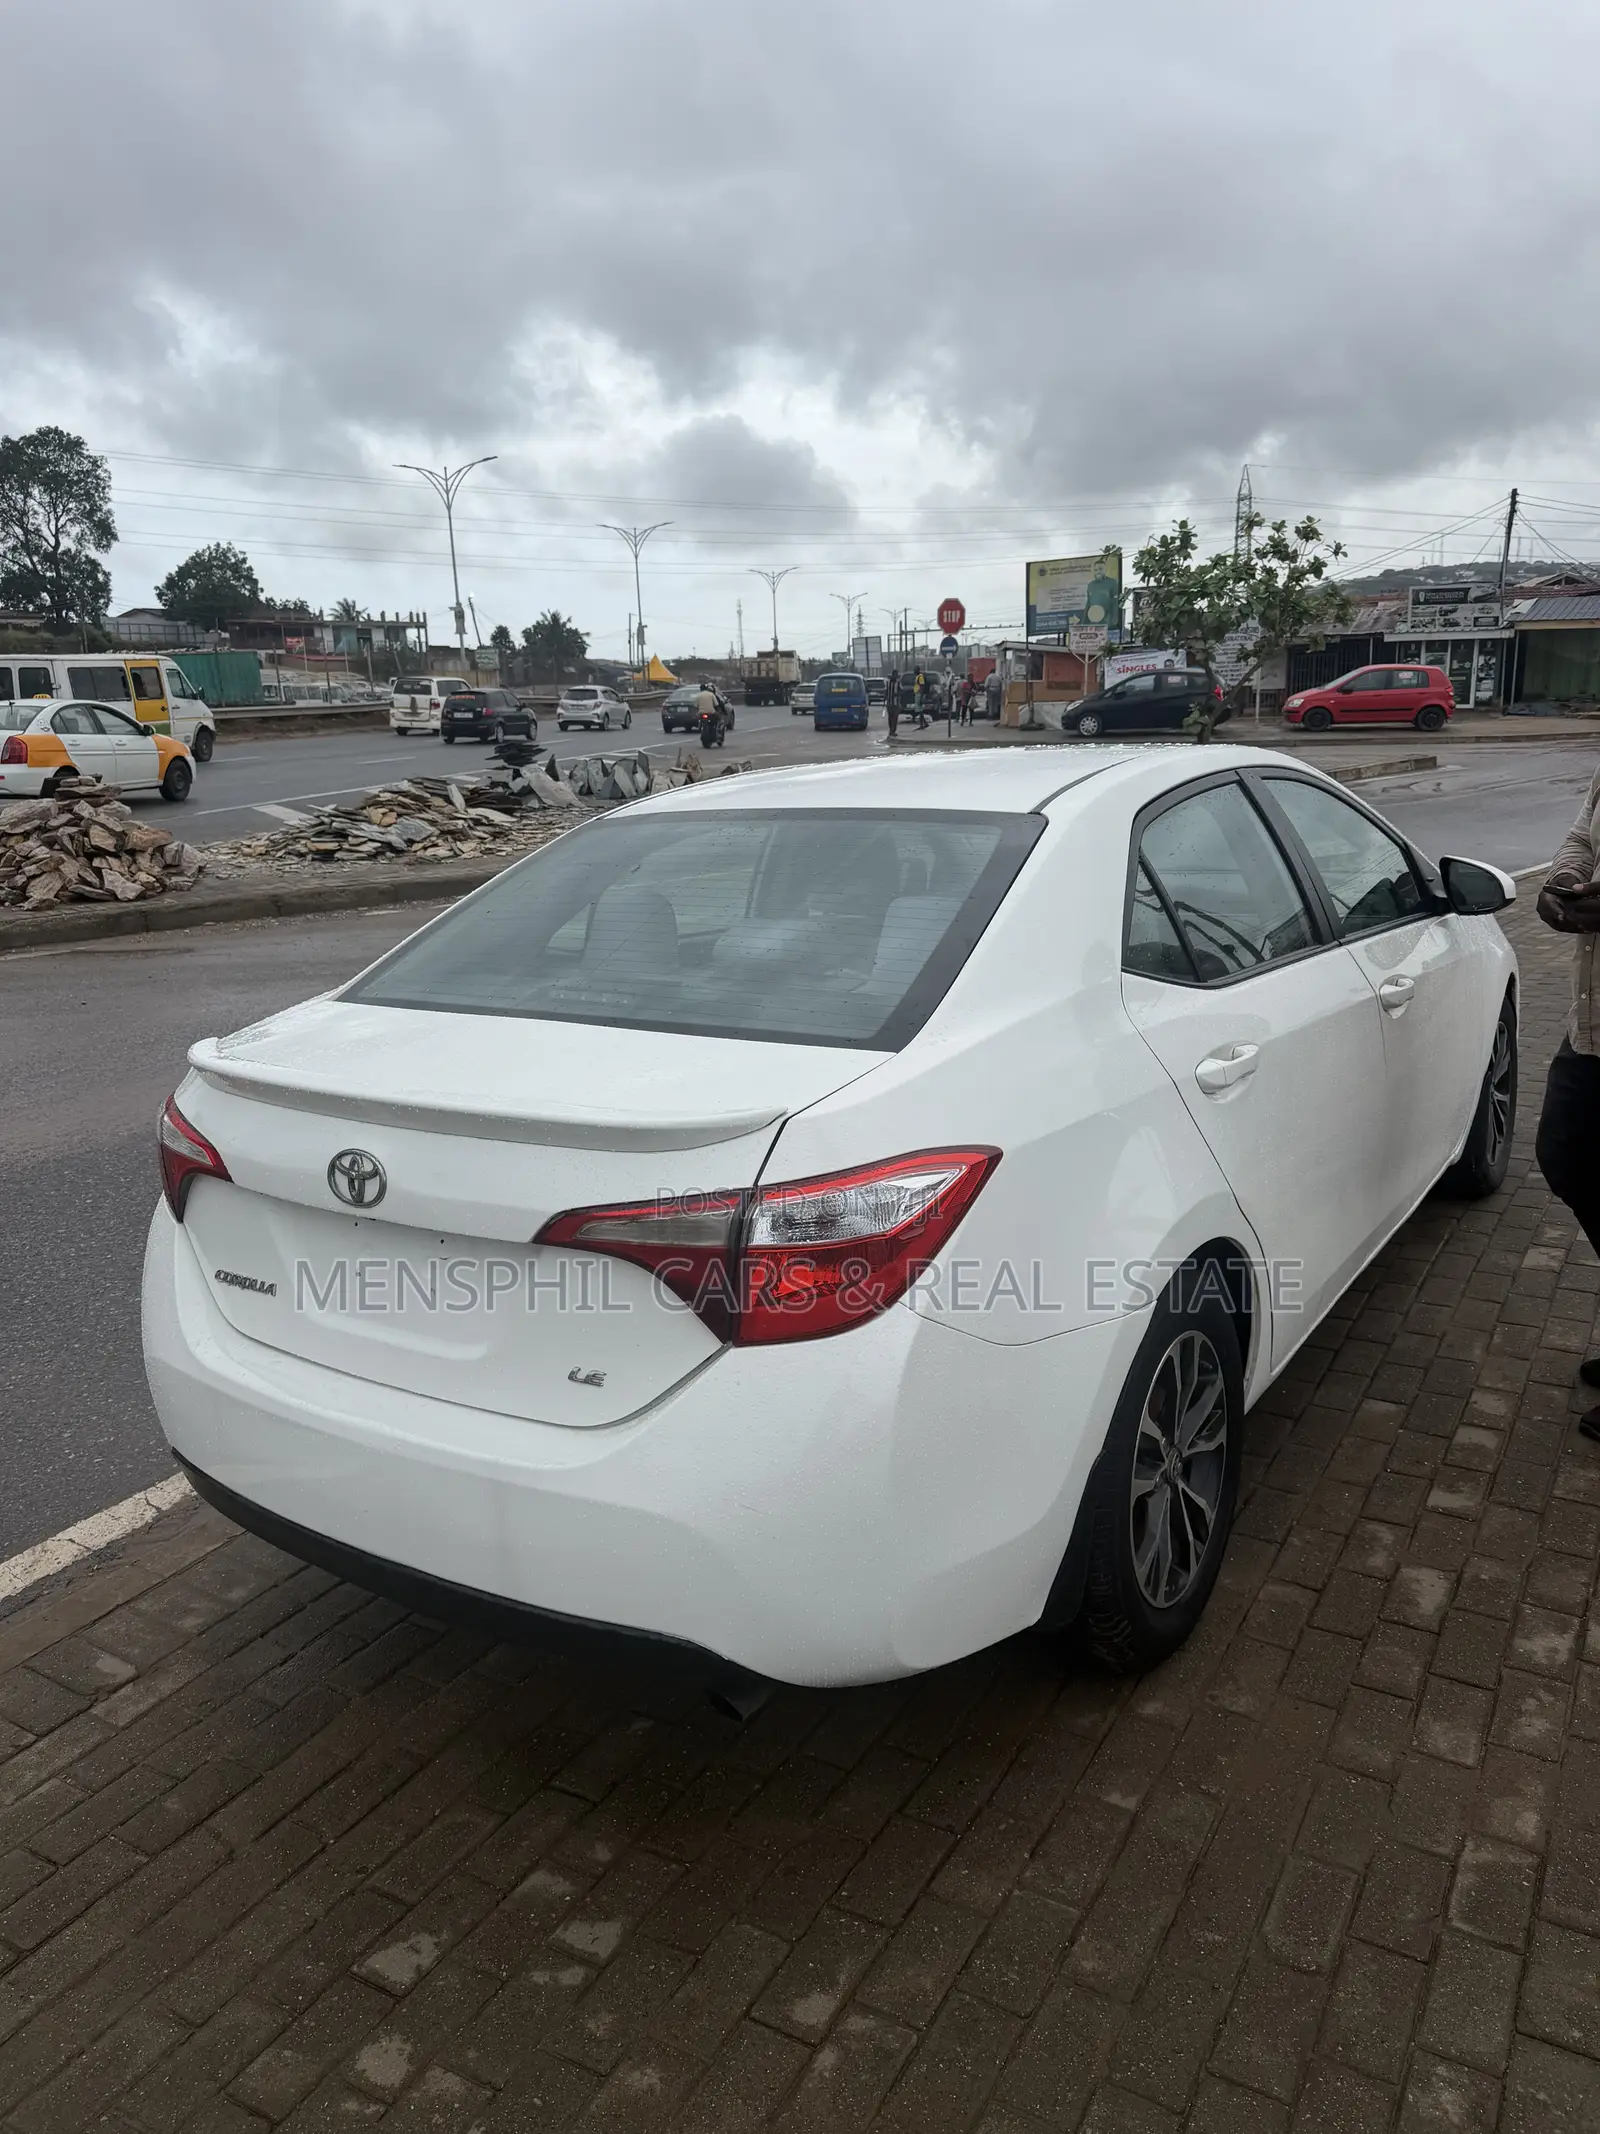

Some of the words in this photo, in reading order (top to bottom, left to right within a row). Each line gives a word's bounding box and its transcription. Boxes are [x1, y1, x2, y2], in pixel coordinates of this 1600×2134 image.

[943, 610, 961, 623] STOP
[215, 1269, 277, 1297] COROLLA
[568, 1366, 607, 1387] LE
